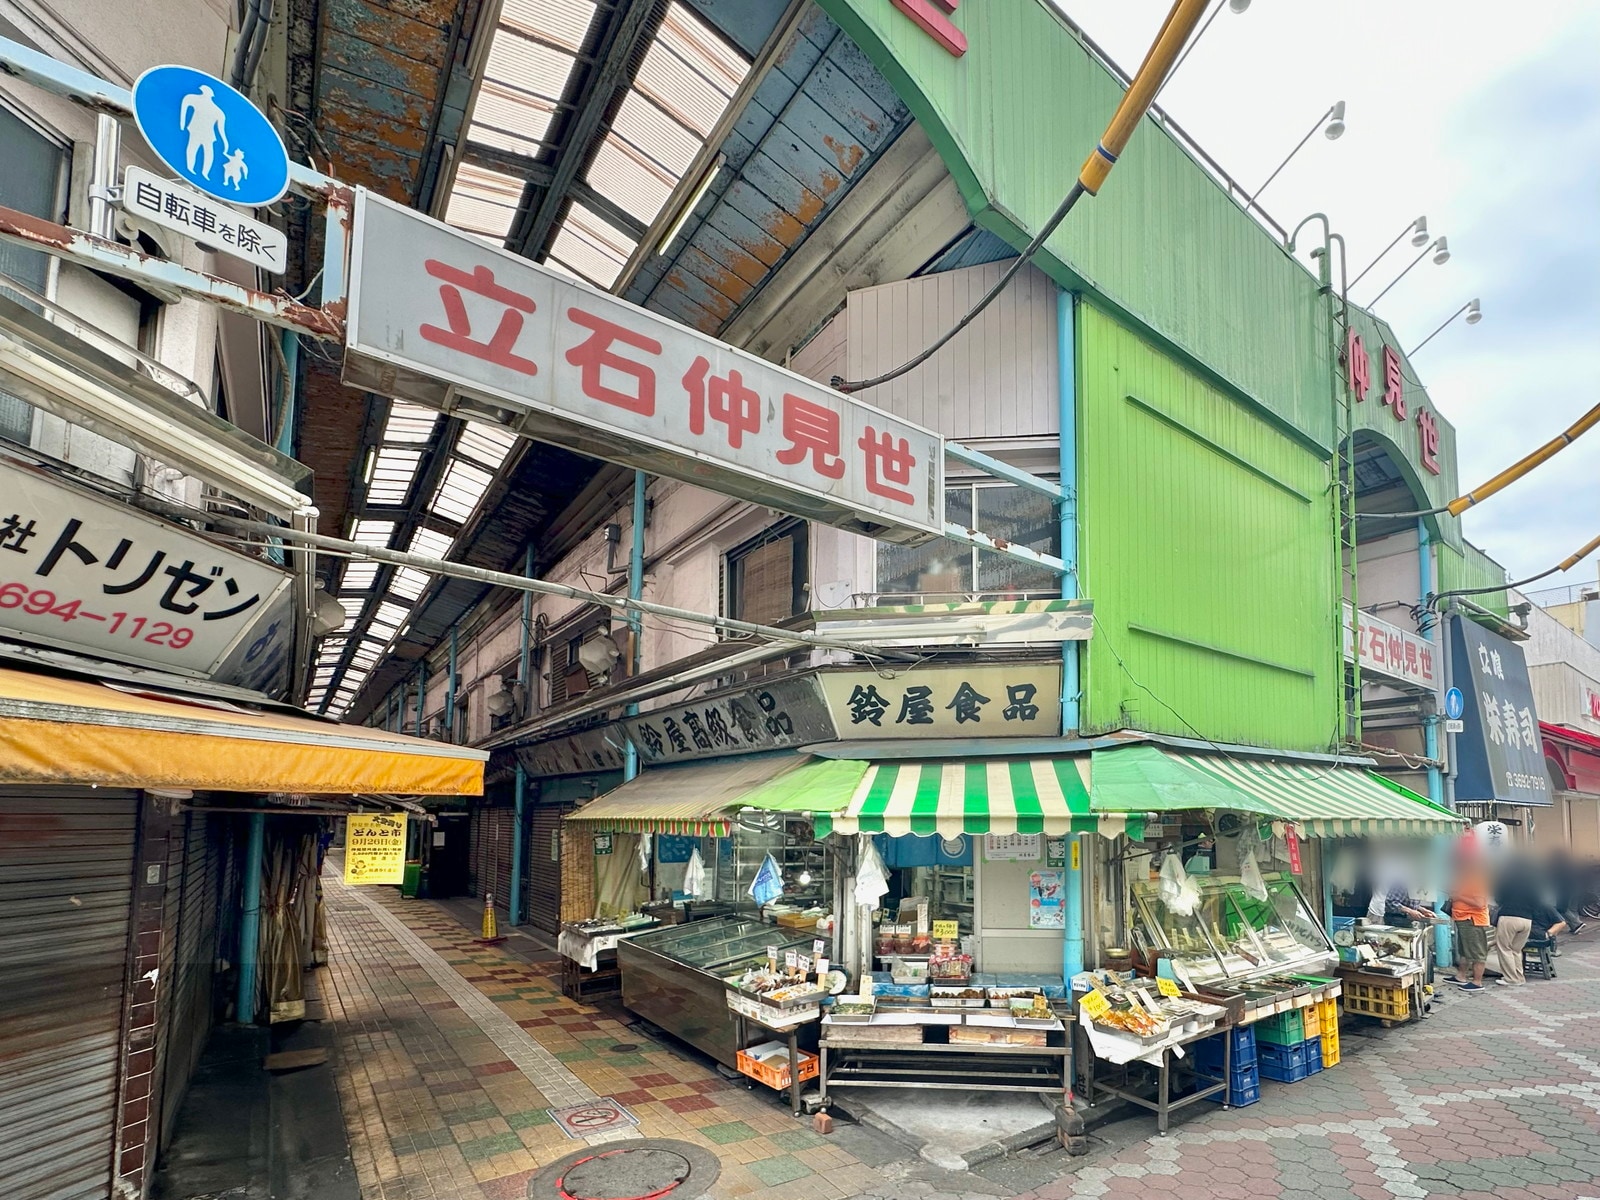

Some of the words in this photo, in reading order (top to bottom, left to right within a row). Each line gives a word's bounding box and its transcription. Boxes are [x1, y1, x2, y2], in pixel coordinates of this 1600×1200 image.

[135, 181, 278, 262] 自転車を除く
[419, 258, 916, 505] 立石仲見世
[1346, 325, 1441, 476] 仲見世
[1349, 620, 1433, 680] 立石仲見世
[846, 681, 1039, 727] 鈴屋食品
[353, 828, 402, 837] どんと市
